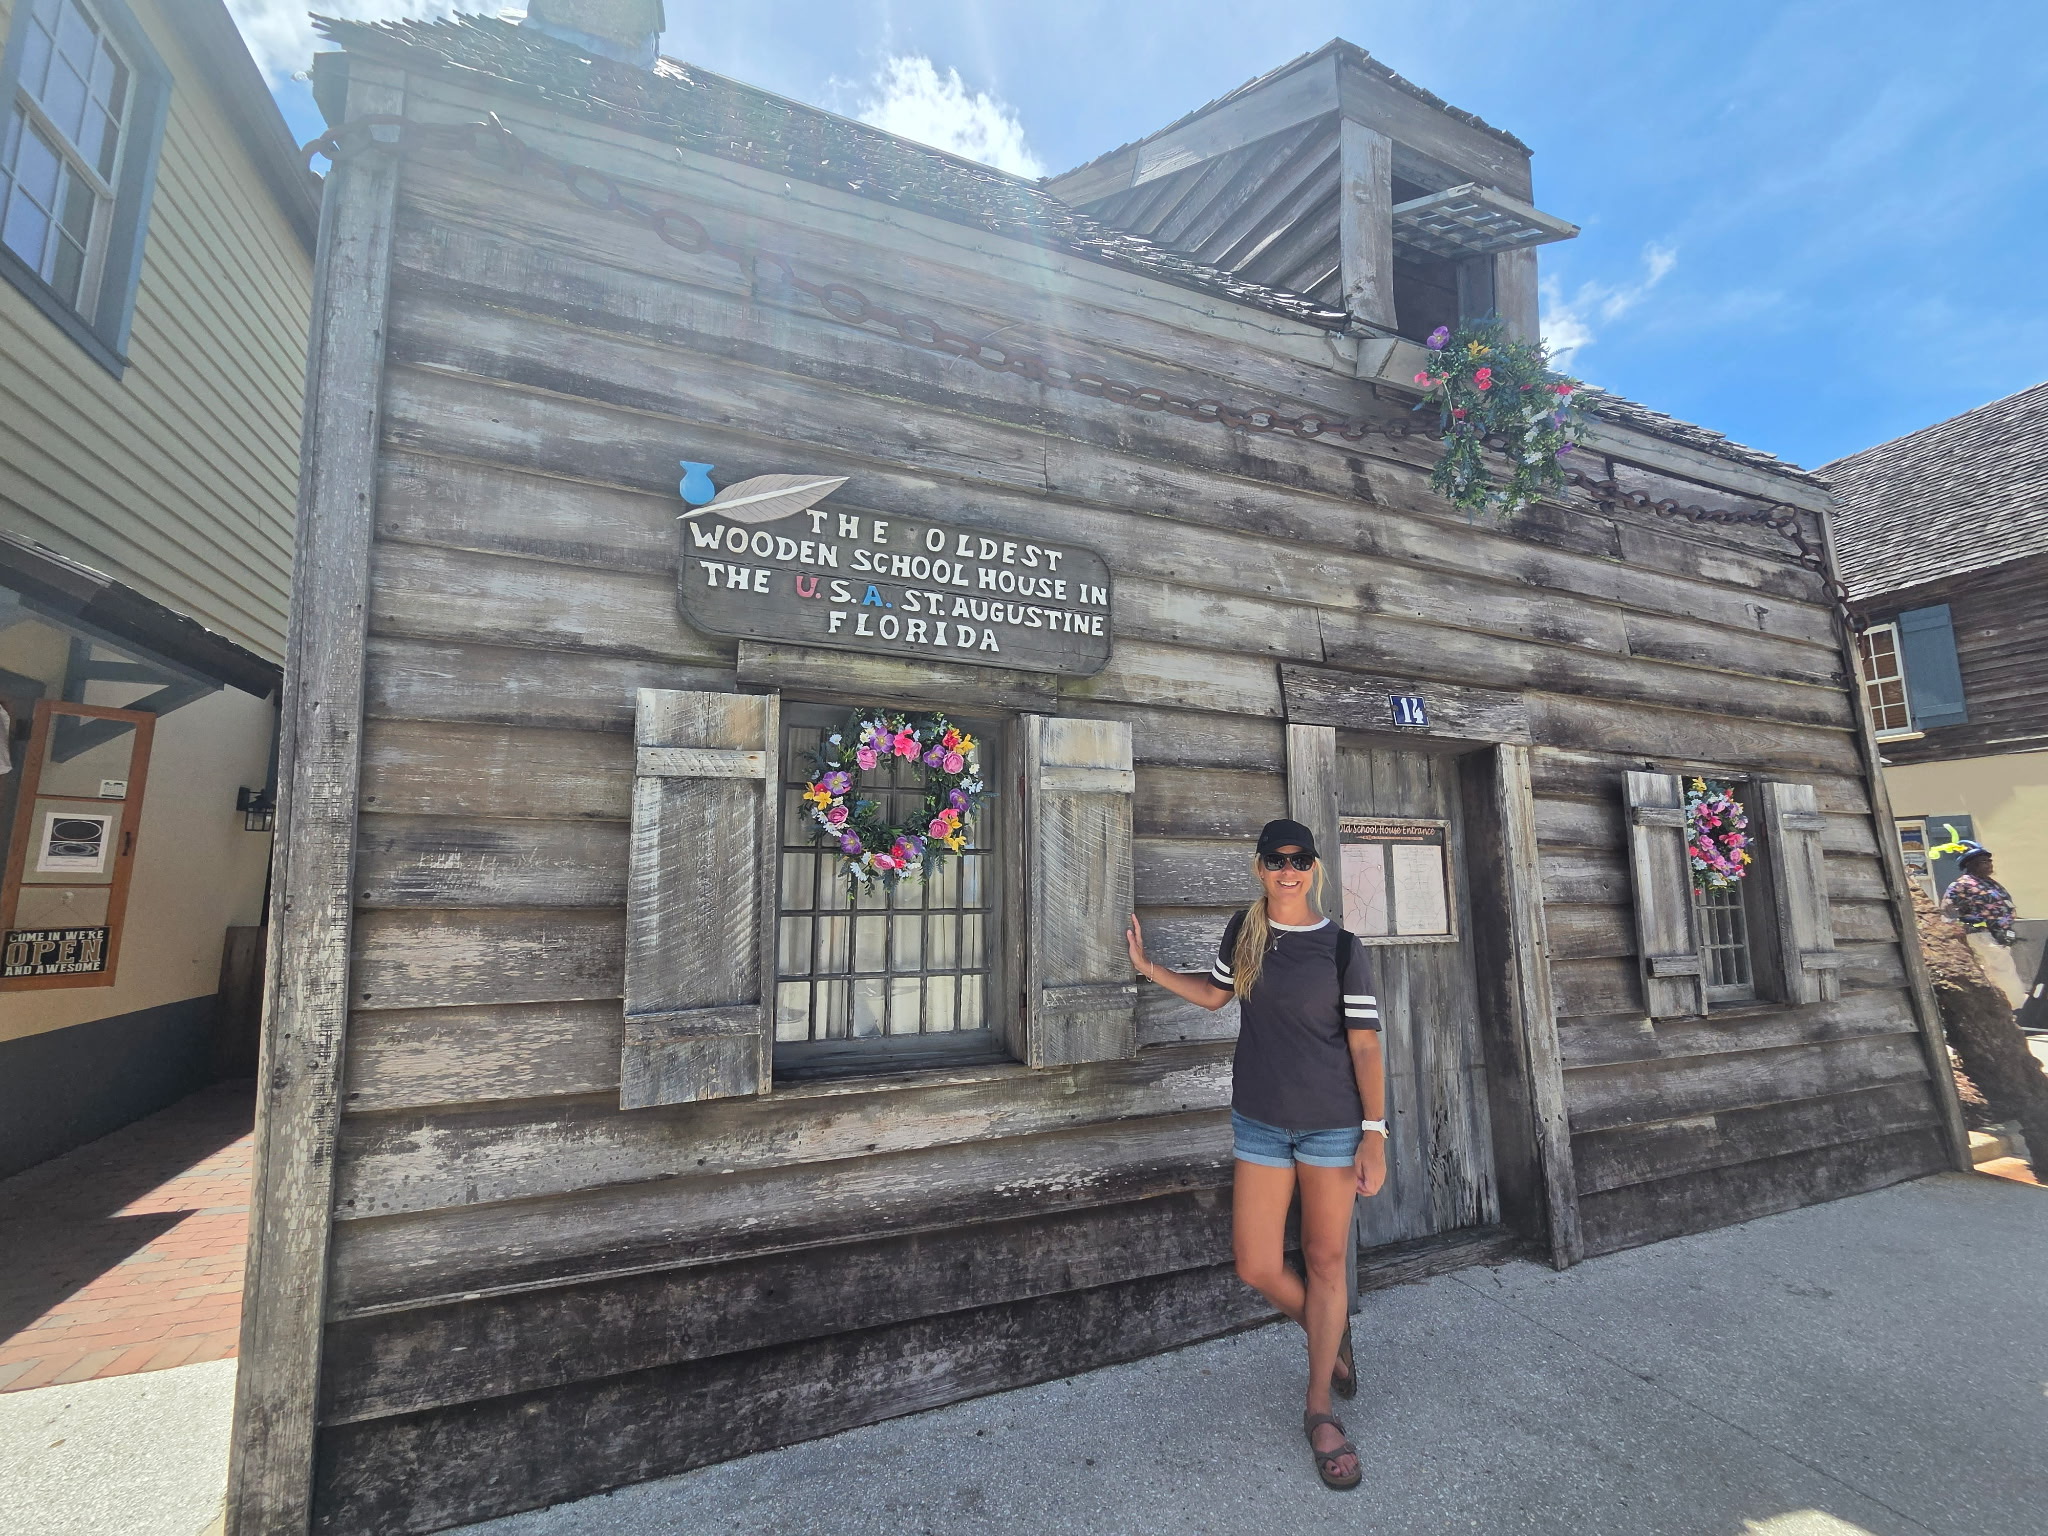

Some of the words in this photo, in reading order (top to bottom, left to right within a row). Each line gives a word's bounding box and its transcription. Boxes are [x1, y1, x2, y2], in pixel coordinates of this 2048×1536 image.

[806, 509, 889, 544] THE
[926, 528, 1063, 571] OLDEST
[689, 521, 838, 567] WOODEN
[850, 549, 969, 587] SCHOOL
[978, 567, 1067, 600] HOUSE
[1079, 583, 1108, 605] IN
[700, 560, 772, 594] THE
[828, 610, 1000, 652] FLORIDA
[1400, 697, 1424, 724] 14
[1352, 824, 1378, 834] School
[1379, 825, 1401, 835] House
[1402, 825, 1435, 836] Entrance
[9, 932, 44, 942] COME
[48, 931, 60, 941] IN
[65, 930, 104, 940] WE'RE
[5, 939, 103, 967] OPEN
[4, 965, 32, 976] AND
[35, 961, 101, 975] AWESOME
